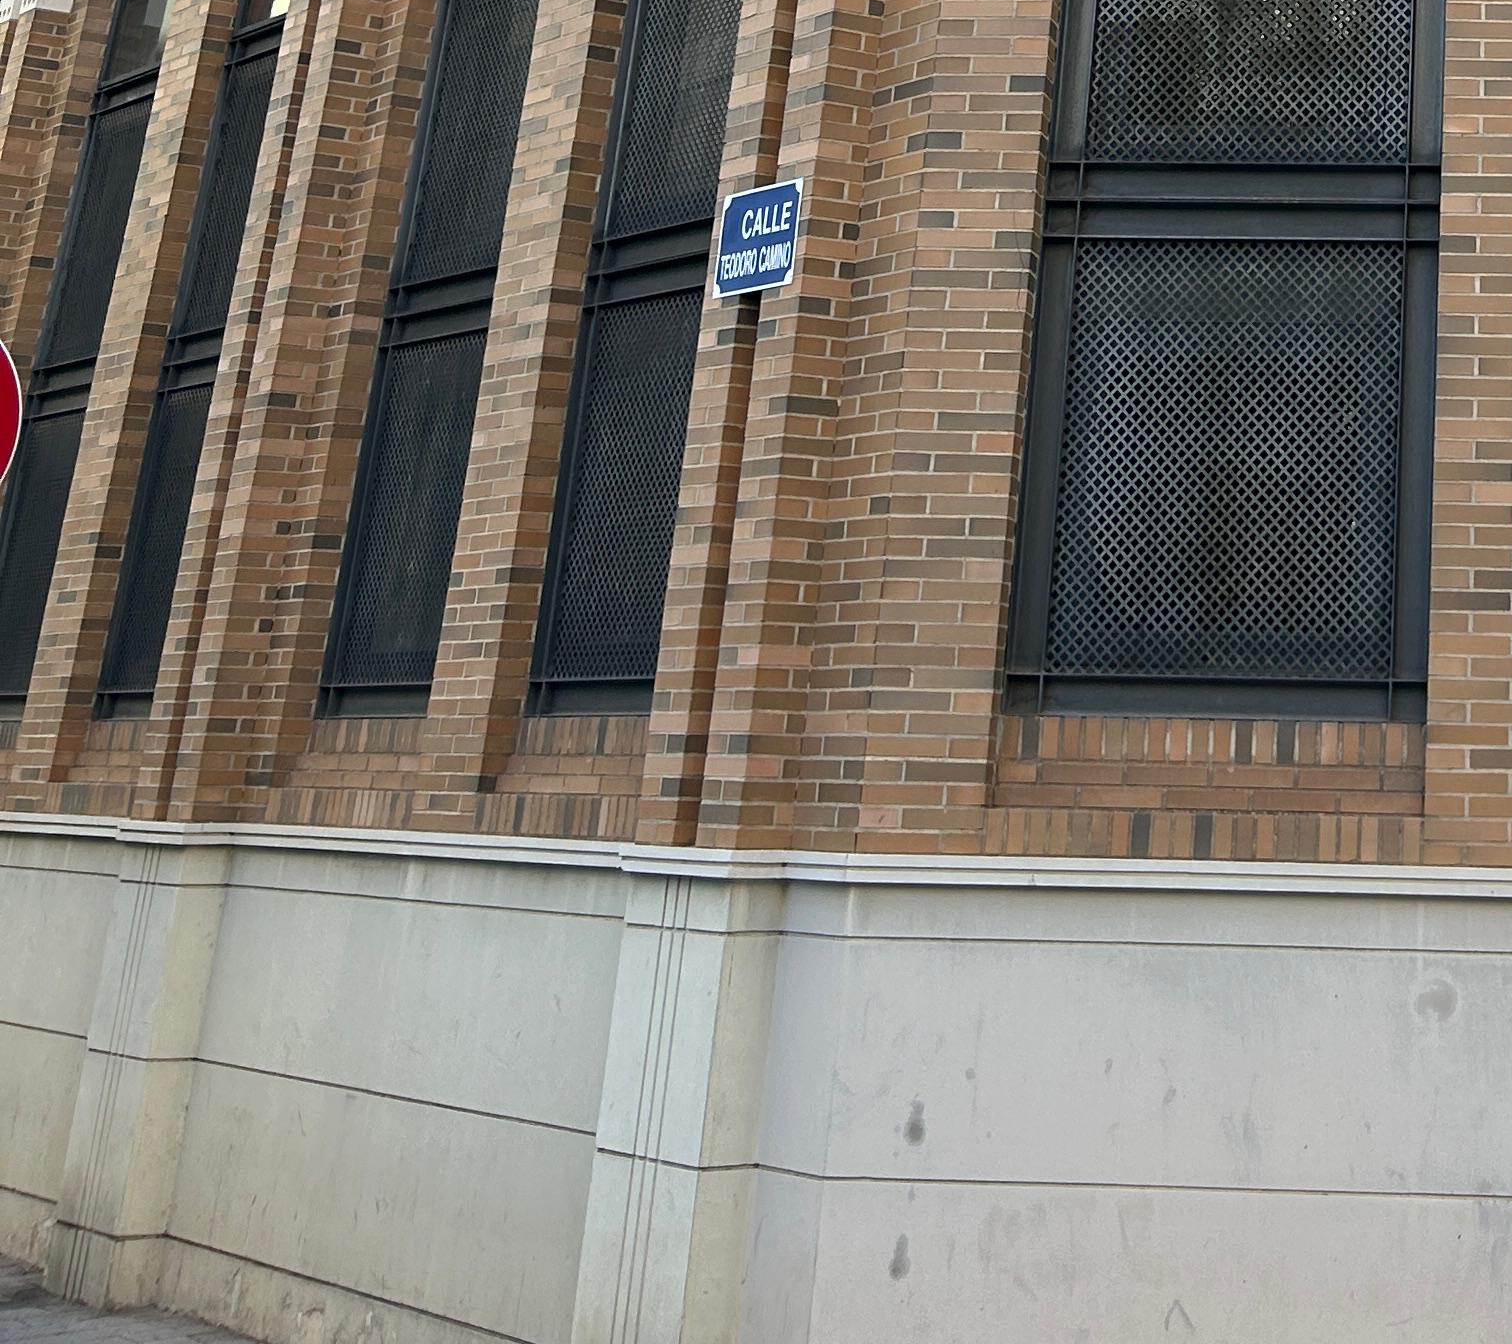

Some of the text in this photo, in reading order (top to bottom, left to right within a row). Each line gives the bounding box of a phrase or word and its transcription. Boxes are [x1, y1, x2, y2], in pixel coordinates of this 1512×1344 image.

[741, 200, 793, 240] CALLE
[720, 240, 792, 281] TEODORO CAMINO
